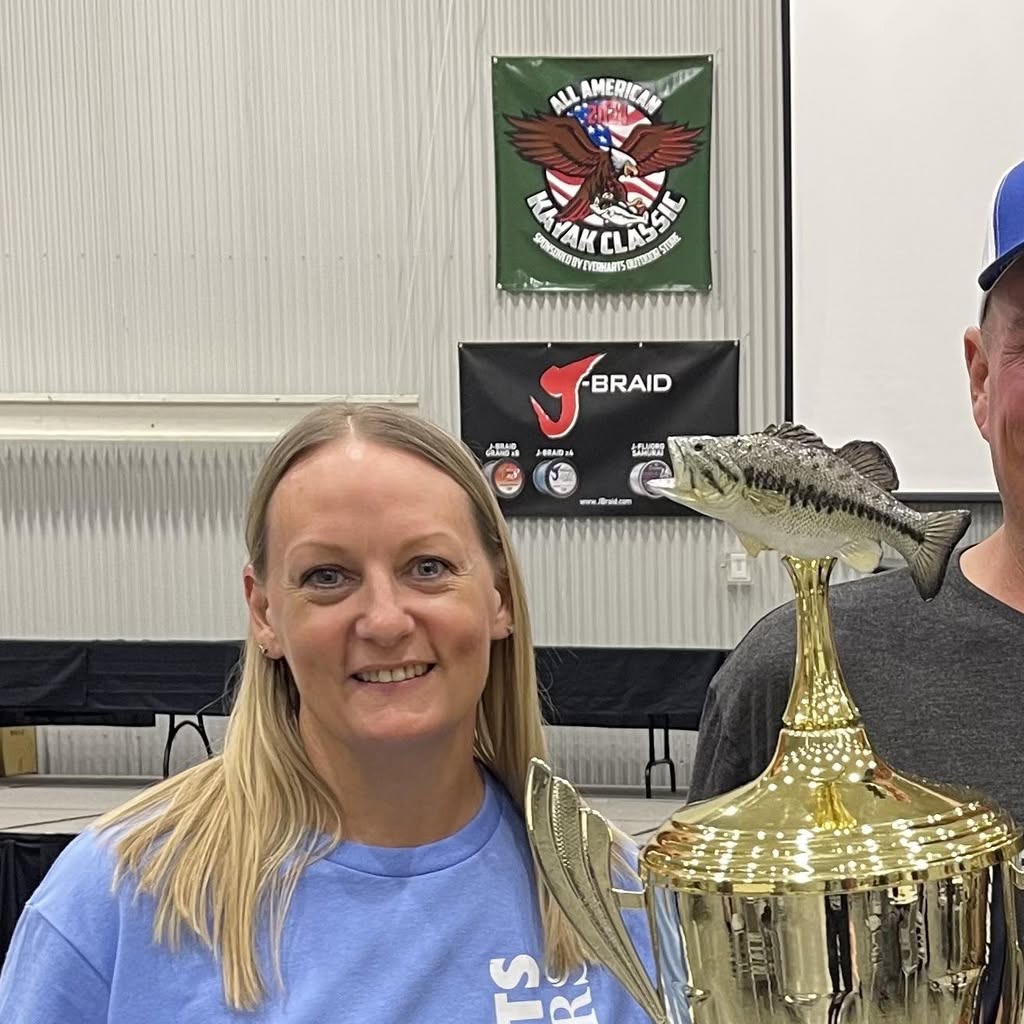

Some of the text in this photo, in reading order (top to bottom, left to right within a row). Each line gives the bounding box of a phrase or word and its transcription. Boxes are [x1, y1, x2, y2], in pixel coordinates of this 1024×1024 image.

[549, 78, 663, 116] ALL AMERICAN
[526, 190, 686, 256] KAYAK CLASSIC
[571, 256, 583, 270] BY
[582, 260, 627, 273] EVERHARTS
[535, 449, 564, 457] J-BRAID
